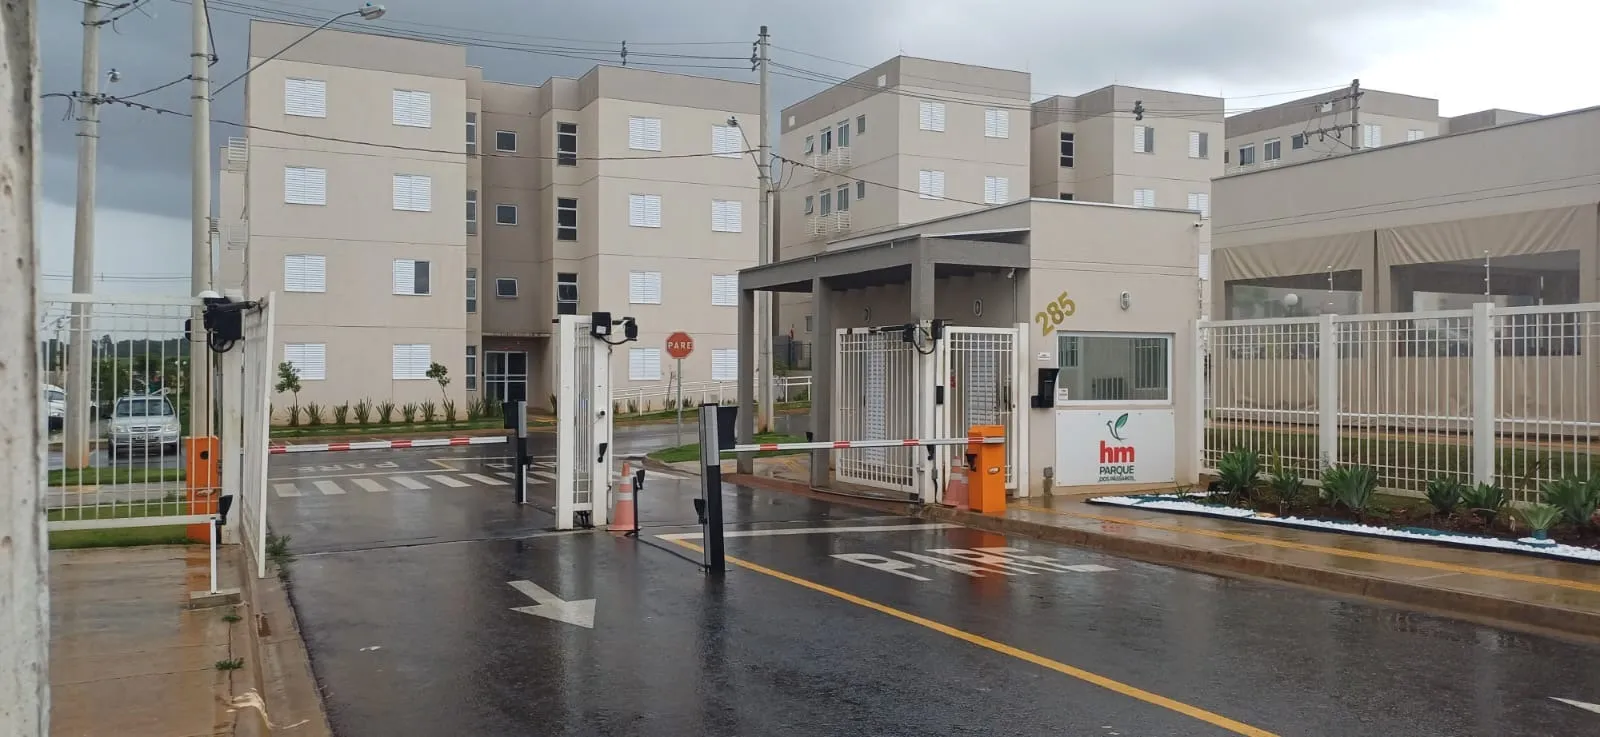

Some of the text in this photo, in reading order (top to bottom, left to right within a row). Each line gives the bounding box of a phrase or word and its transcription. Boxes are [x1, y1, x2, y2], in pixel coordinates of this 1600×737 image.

[1035, 291, 1075, 337] 285
[668, 341, 693, 350] PARE
[1100, 440, 1135, 464] hm
[1100, 465, 1135, 475] PARQUE
[828, 547, 1119, 581] PARE
